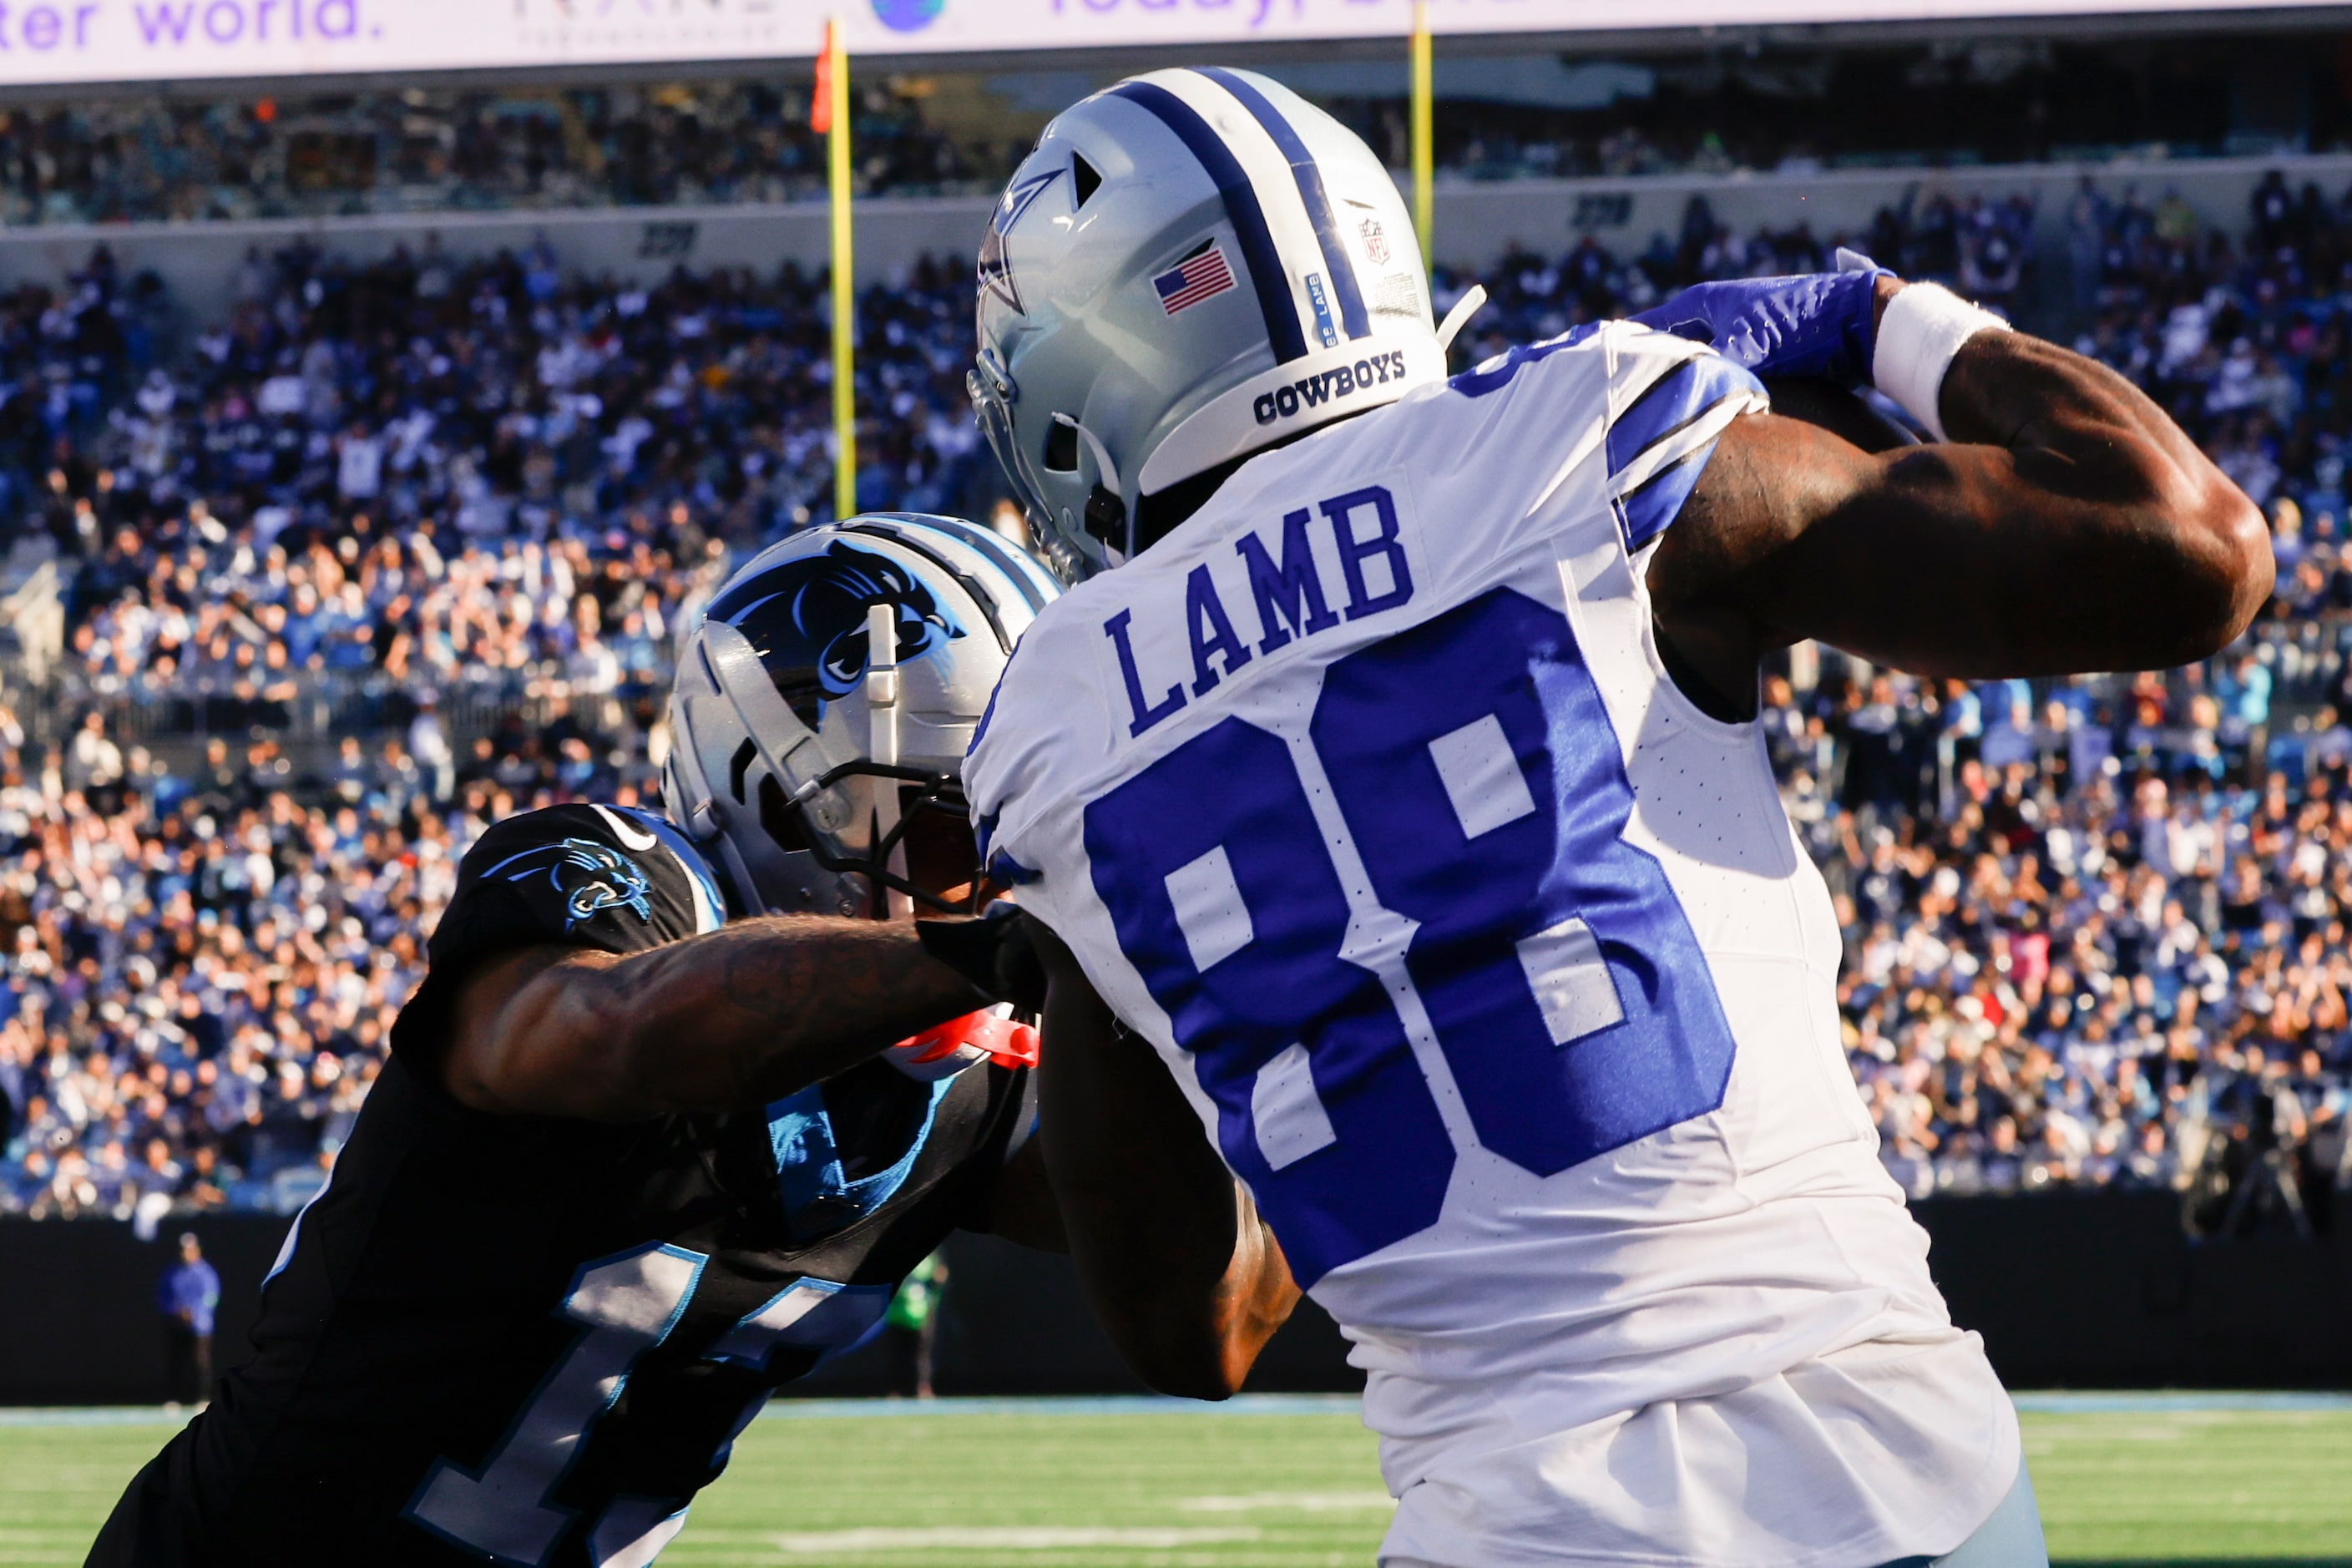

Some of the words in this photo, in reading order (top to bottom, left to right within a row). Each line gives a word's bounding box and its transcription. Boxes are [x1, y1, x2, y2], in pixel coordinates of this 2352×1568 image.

[134, 0, 383, 45] world.
[1365, 237, 1388, 260] NFL
[1253, 349, 1406, 427] COWBOYS
[1103, 484, 1414, 739] LAMB
[1083, 584, 1737, 1294] 88
